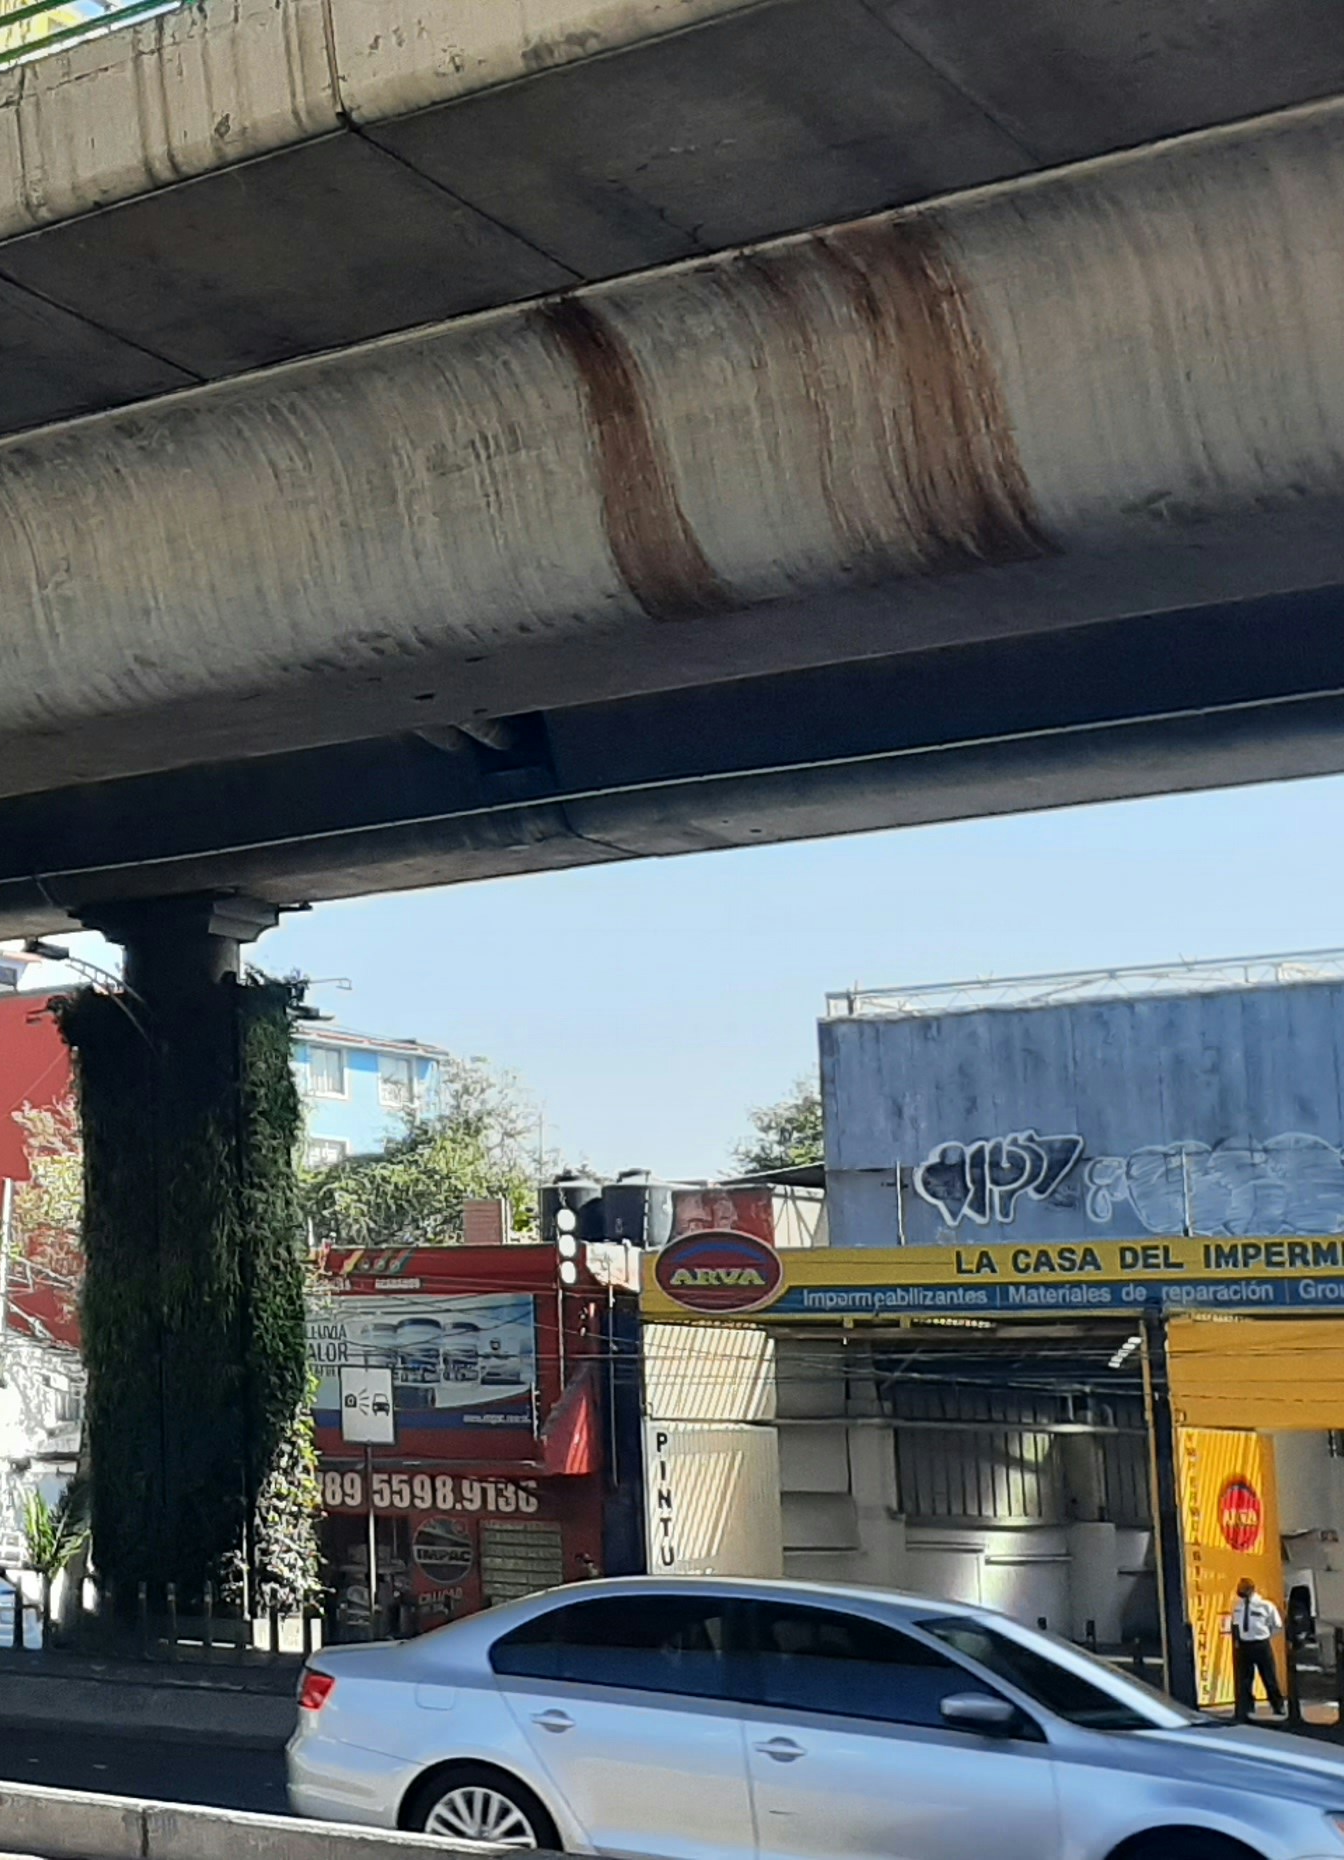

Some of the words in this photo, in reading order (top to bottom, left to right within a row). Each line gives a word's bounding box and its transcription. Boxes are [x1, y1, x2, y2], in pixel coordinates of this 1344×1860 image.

[955, 1250, 997, 1274] LA
[1012, 1247, 1102, 1274] CASA
[1119, 1245, 1184, 1270] DEL
[1203, 1241, 1344, 1269] IMPERM
[670, 1268, 765, 1285] ARVA
[803, 1287, 987, 1307] Impermeabilizantes
[1009, 1284, 1111, 1304] Materiales
[1122, 1283, 1146, 1300] de
[1161, 1280, 1274, 1304] reparación
